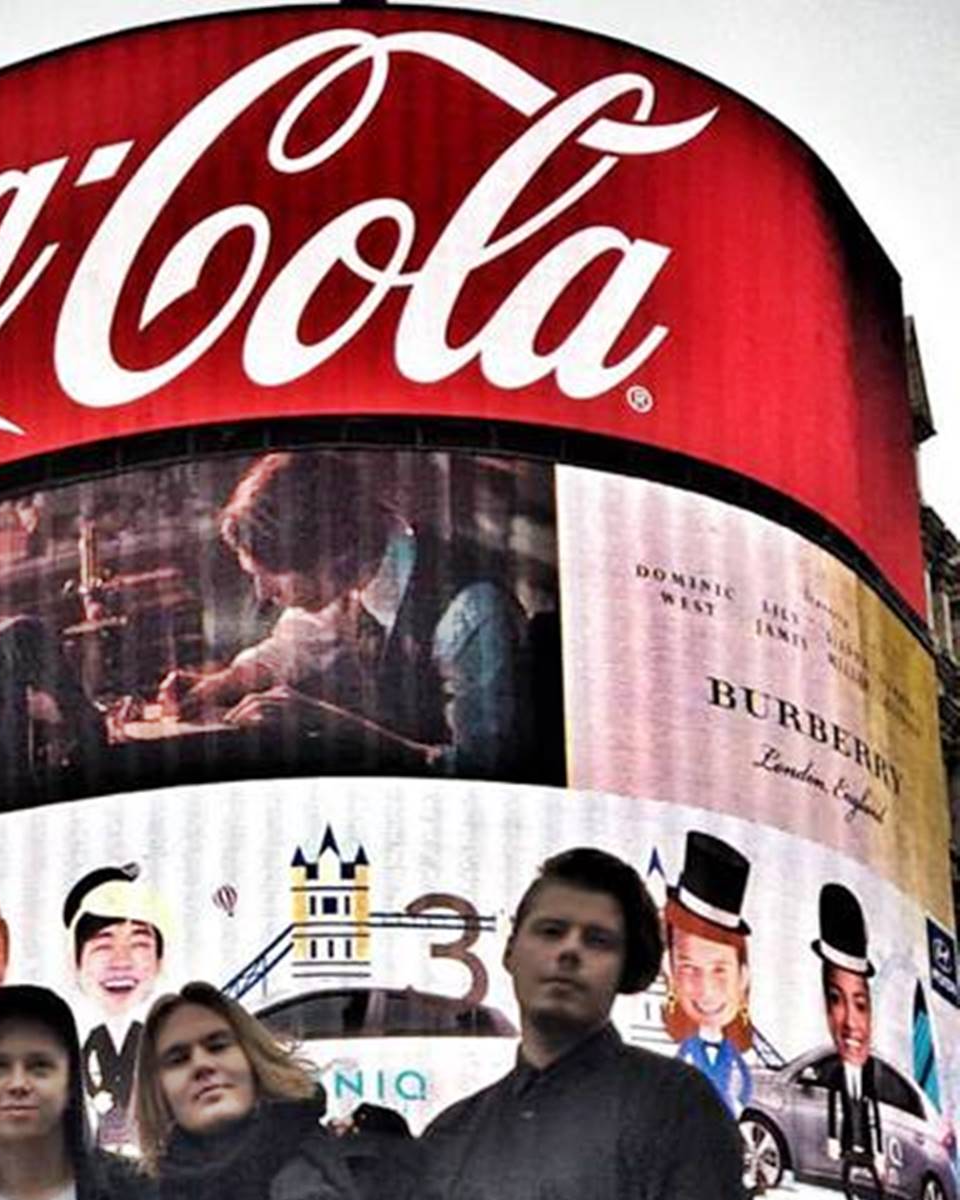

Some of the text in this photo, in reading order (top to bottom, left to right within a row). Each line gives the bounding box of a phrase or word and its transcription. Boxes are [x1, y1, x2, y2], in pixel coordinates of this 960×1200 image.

[635, 563, 737, 601] DOMINIC
[660, 590, 715, 617] WEST
[706, 675, 903, 796] BURBERRY
